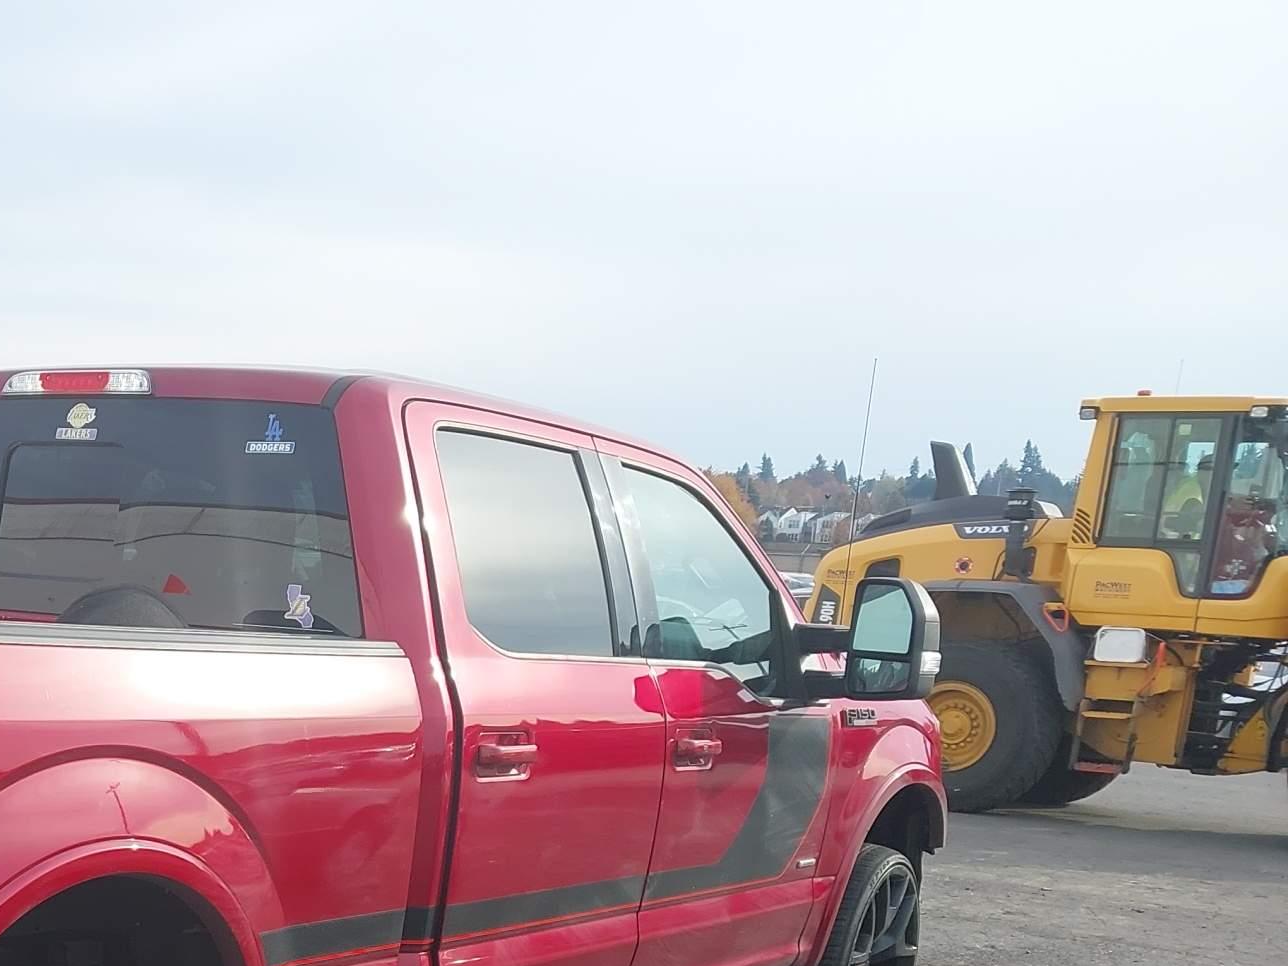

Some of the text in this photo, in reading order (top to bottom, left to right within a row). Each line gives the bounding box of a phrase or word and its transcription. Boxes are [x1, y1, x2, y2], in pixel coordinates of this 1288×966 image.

[63, 428, 91, 440] LAKERS
[265, 414, 283, 441] LA
[249, 443, 291, 452] DODGERS
[819, 600, 837, 625] 90H
